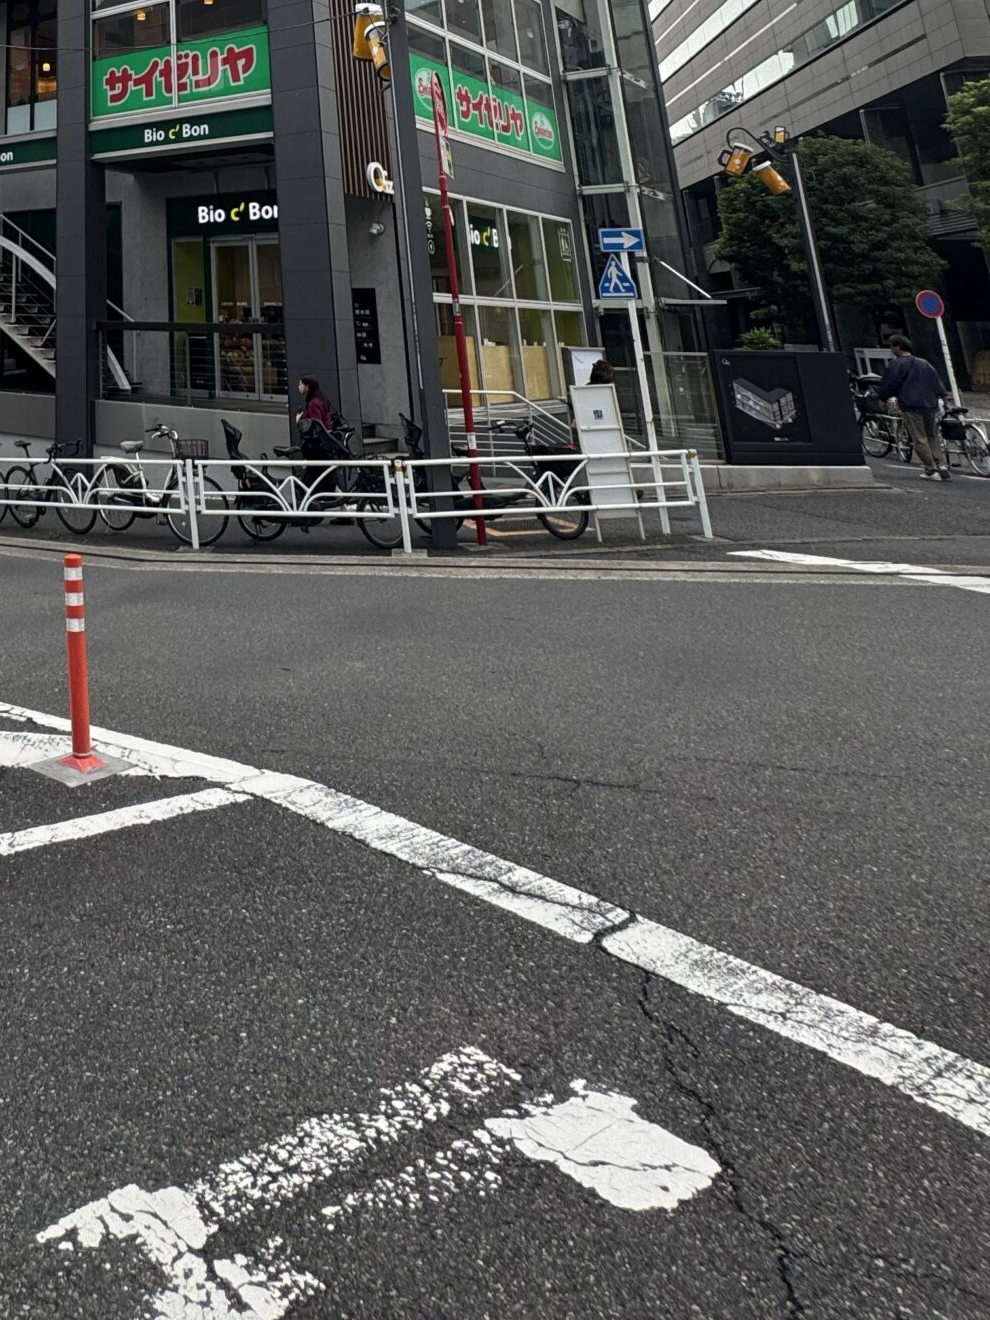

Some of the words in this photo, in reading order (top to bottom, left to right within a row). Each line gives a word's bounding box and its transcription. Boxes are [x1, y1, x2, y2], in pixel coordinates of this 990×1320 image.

[103, 43, 257, 106] サイゼリヤ
[454, 83, 525, 141] サイゼリヤ
[143, 129, 166, 143] Bio
[182, 122, 209, 138] Bon
[197, 205, 226, 224] Bio
